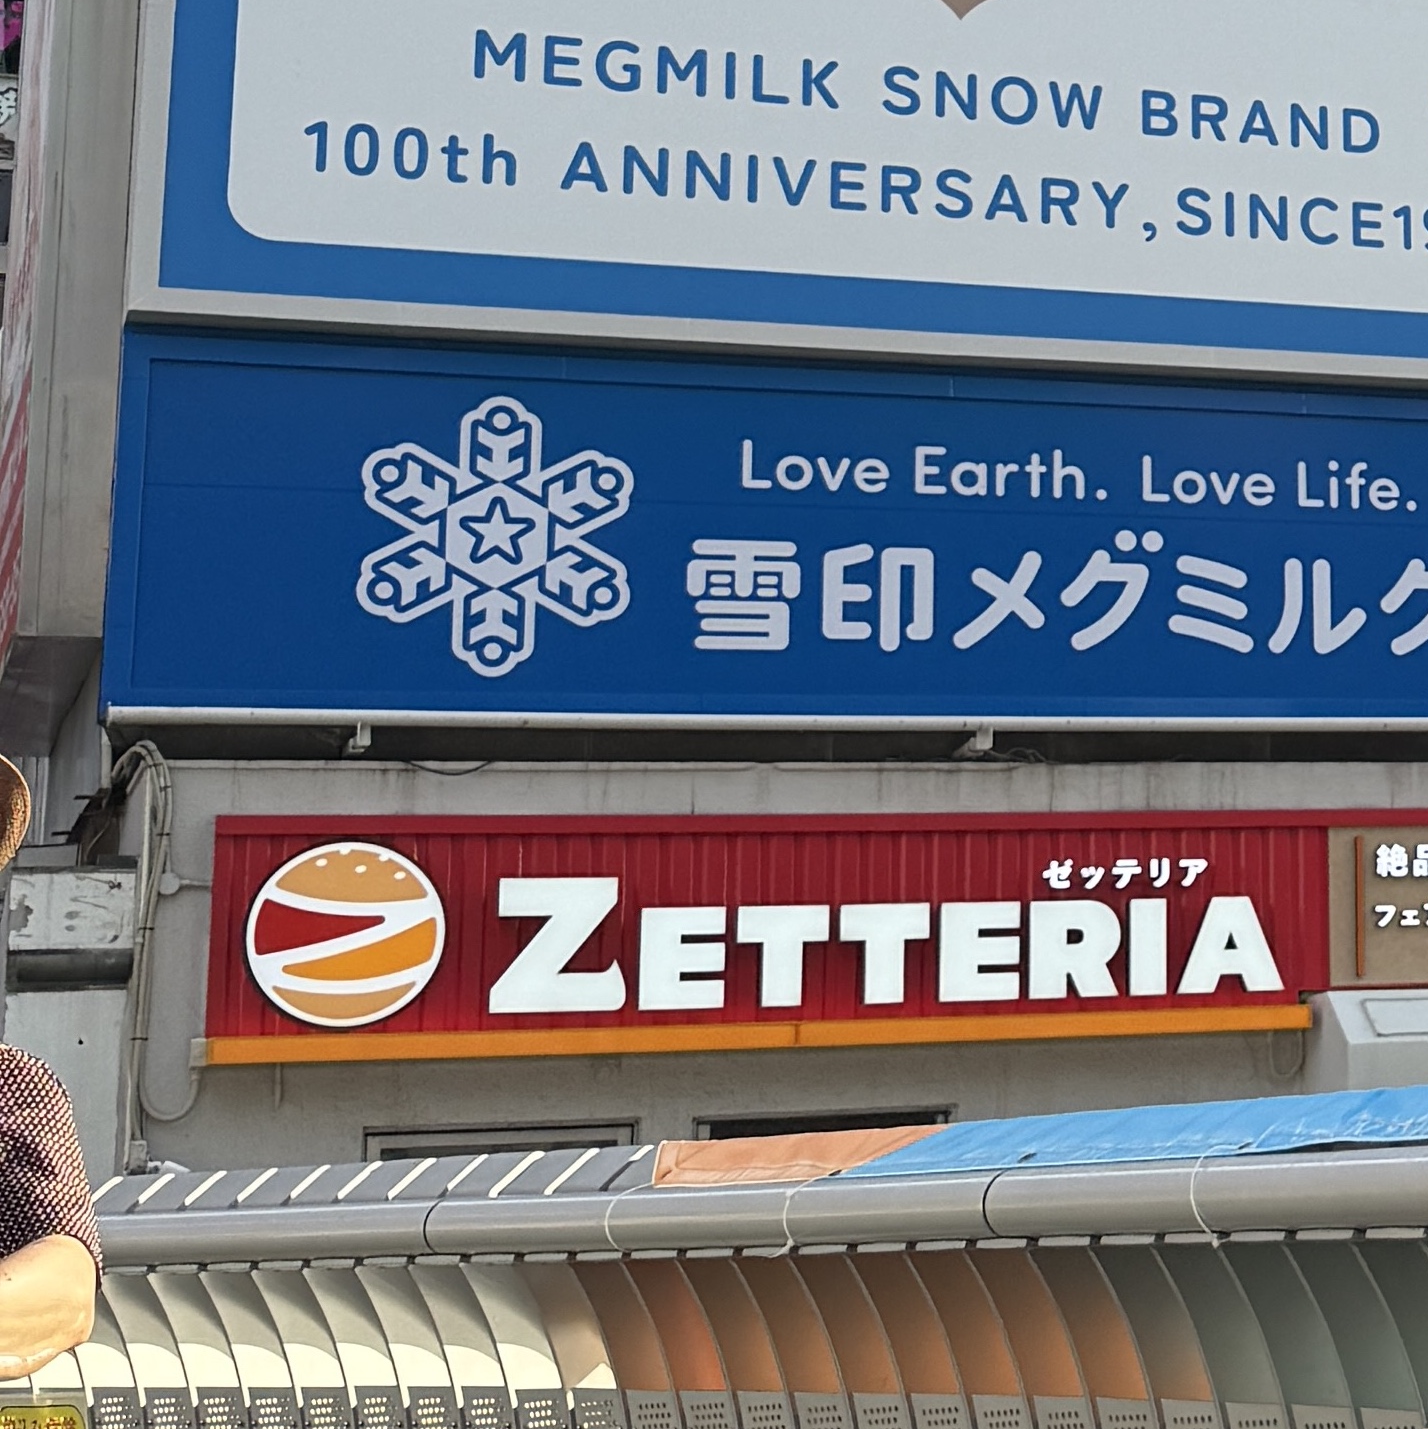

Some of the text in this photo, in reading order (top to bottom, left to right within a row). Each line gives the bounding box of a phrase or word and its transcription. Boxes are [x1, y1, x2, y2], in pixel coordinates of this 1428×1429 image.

[474, 29, 1380, 154] MEGMILK SNOW BRAND
[304, 121, 517, 185] 100th
[741, 439, 1419, 512] Love Earth. Love Life.
[1042, 857, 1208, 890] ゼッテリア
[489, 877, 1285, 1013] ZETTERIA
